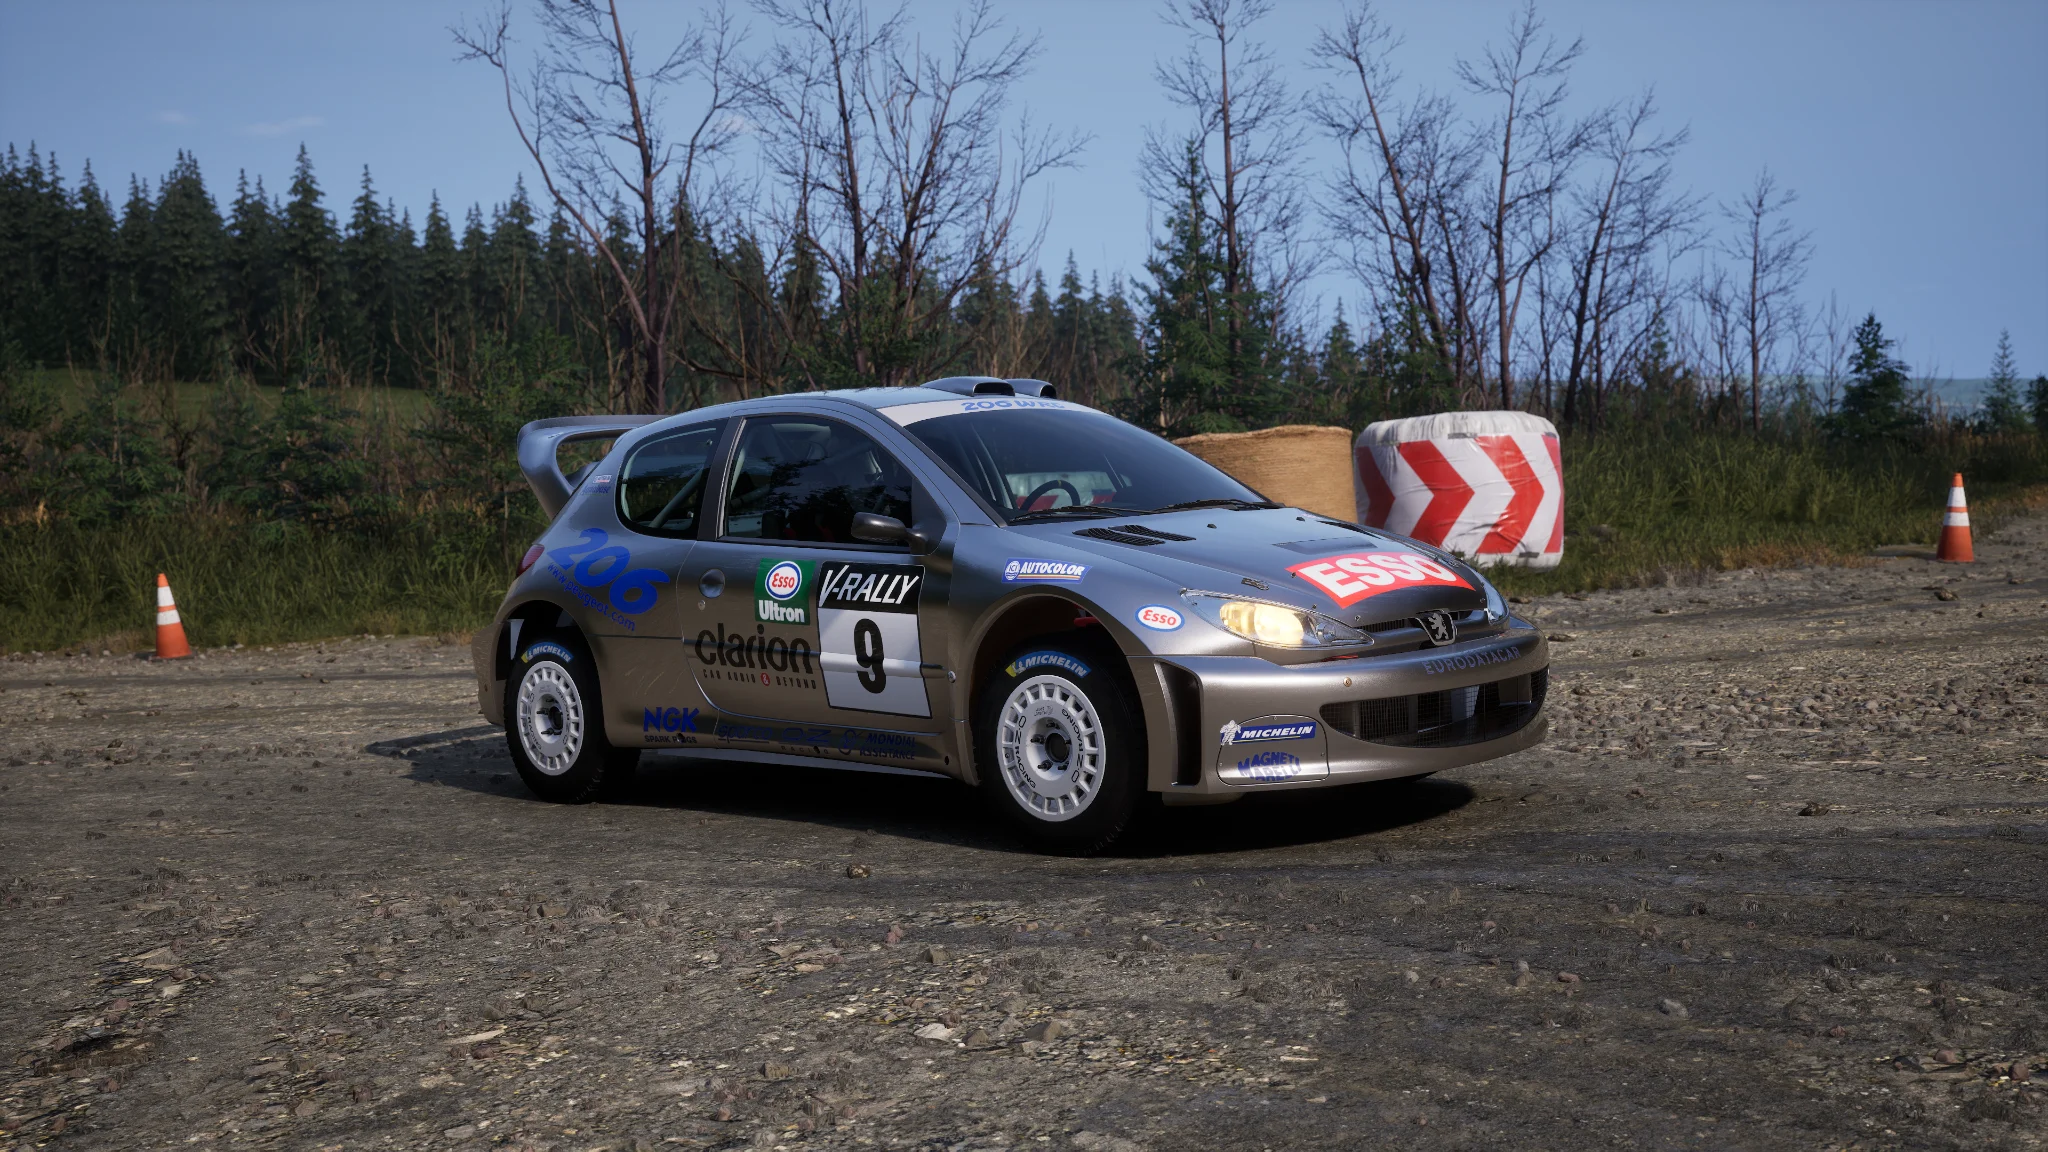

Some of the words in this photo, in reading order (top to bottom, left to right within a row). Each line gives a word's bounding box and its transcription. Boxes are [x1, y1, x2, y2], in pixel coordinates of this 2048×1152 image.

[961, 400, 1013, 411] 206
[547, 528, 670, 615] 206
[1020, 561, 1086, 576] AUTOCOLOR
[1298, 554, 1457, 599] ESSO
[771, 573, 795, 588] Esso
[818, 565, 920, 608] V-RALLY
[547, 562, 636, 632] www.peugeot.com
[758, 599, 805, 622] Ultron
[1142, 609, 1177, 626] Esso
[533, 645, 572, 662] MICHELIN
[695, 623, 814, 675] clarion
[853, 618, 887, 694] 9
[1025, 654, 1088, 677] MICHELIN
[1421, 646, 1521, 675] EURODATACAR
[703, 668, 721, 680] CAR
[727, 671, 756, 684] AUDIO
[775, 676, 817, 690] BEYOND
[643, 706, 700, 733] NGK
[644, 735, 671, 743] SPARK
[672, 735, 698, 744] PGS
[718, 725, 773, 744] sparco
[781, 727, 832, 743] OZ
[866, 732, 916, 747] MONDIAL
[1241, 726, 1313, 739] MICHELIN
[781, 745, 830, 755] RACIG
[860, 746, 916, 760] ASSISTANCE
